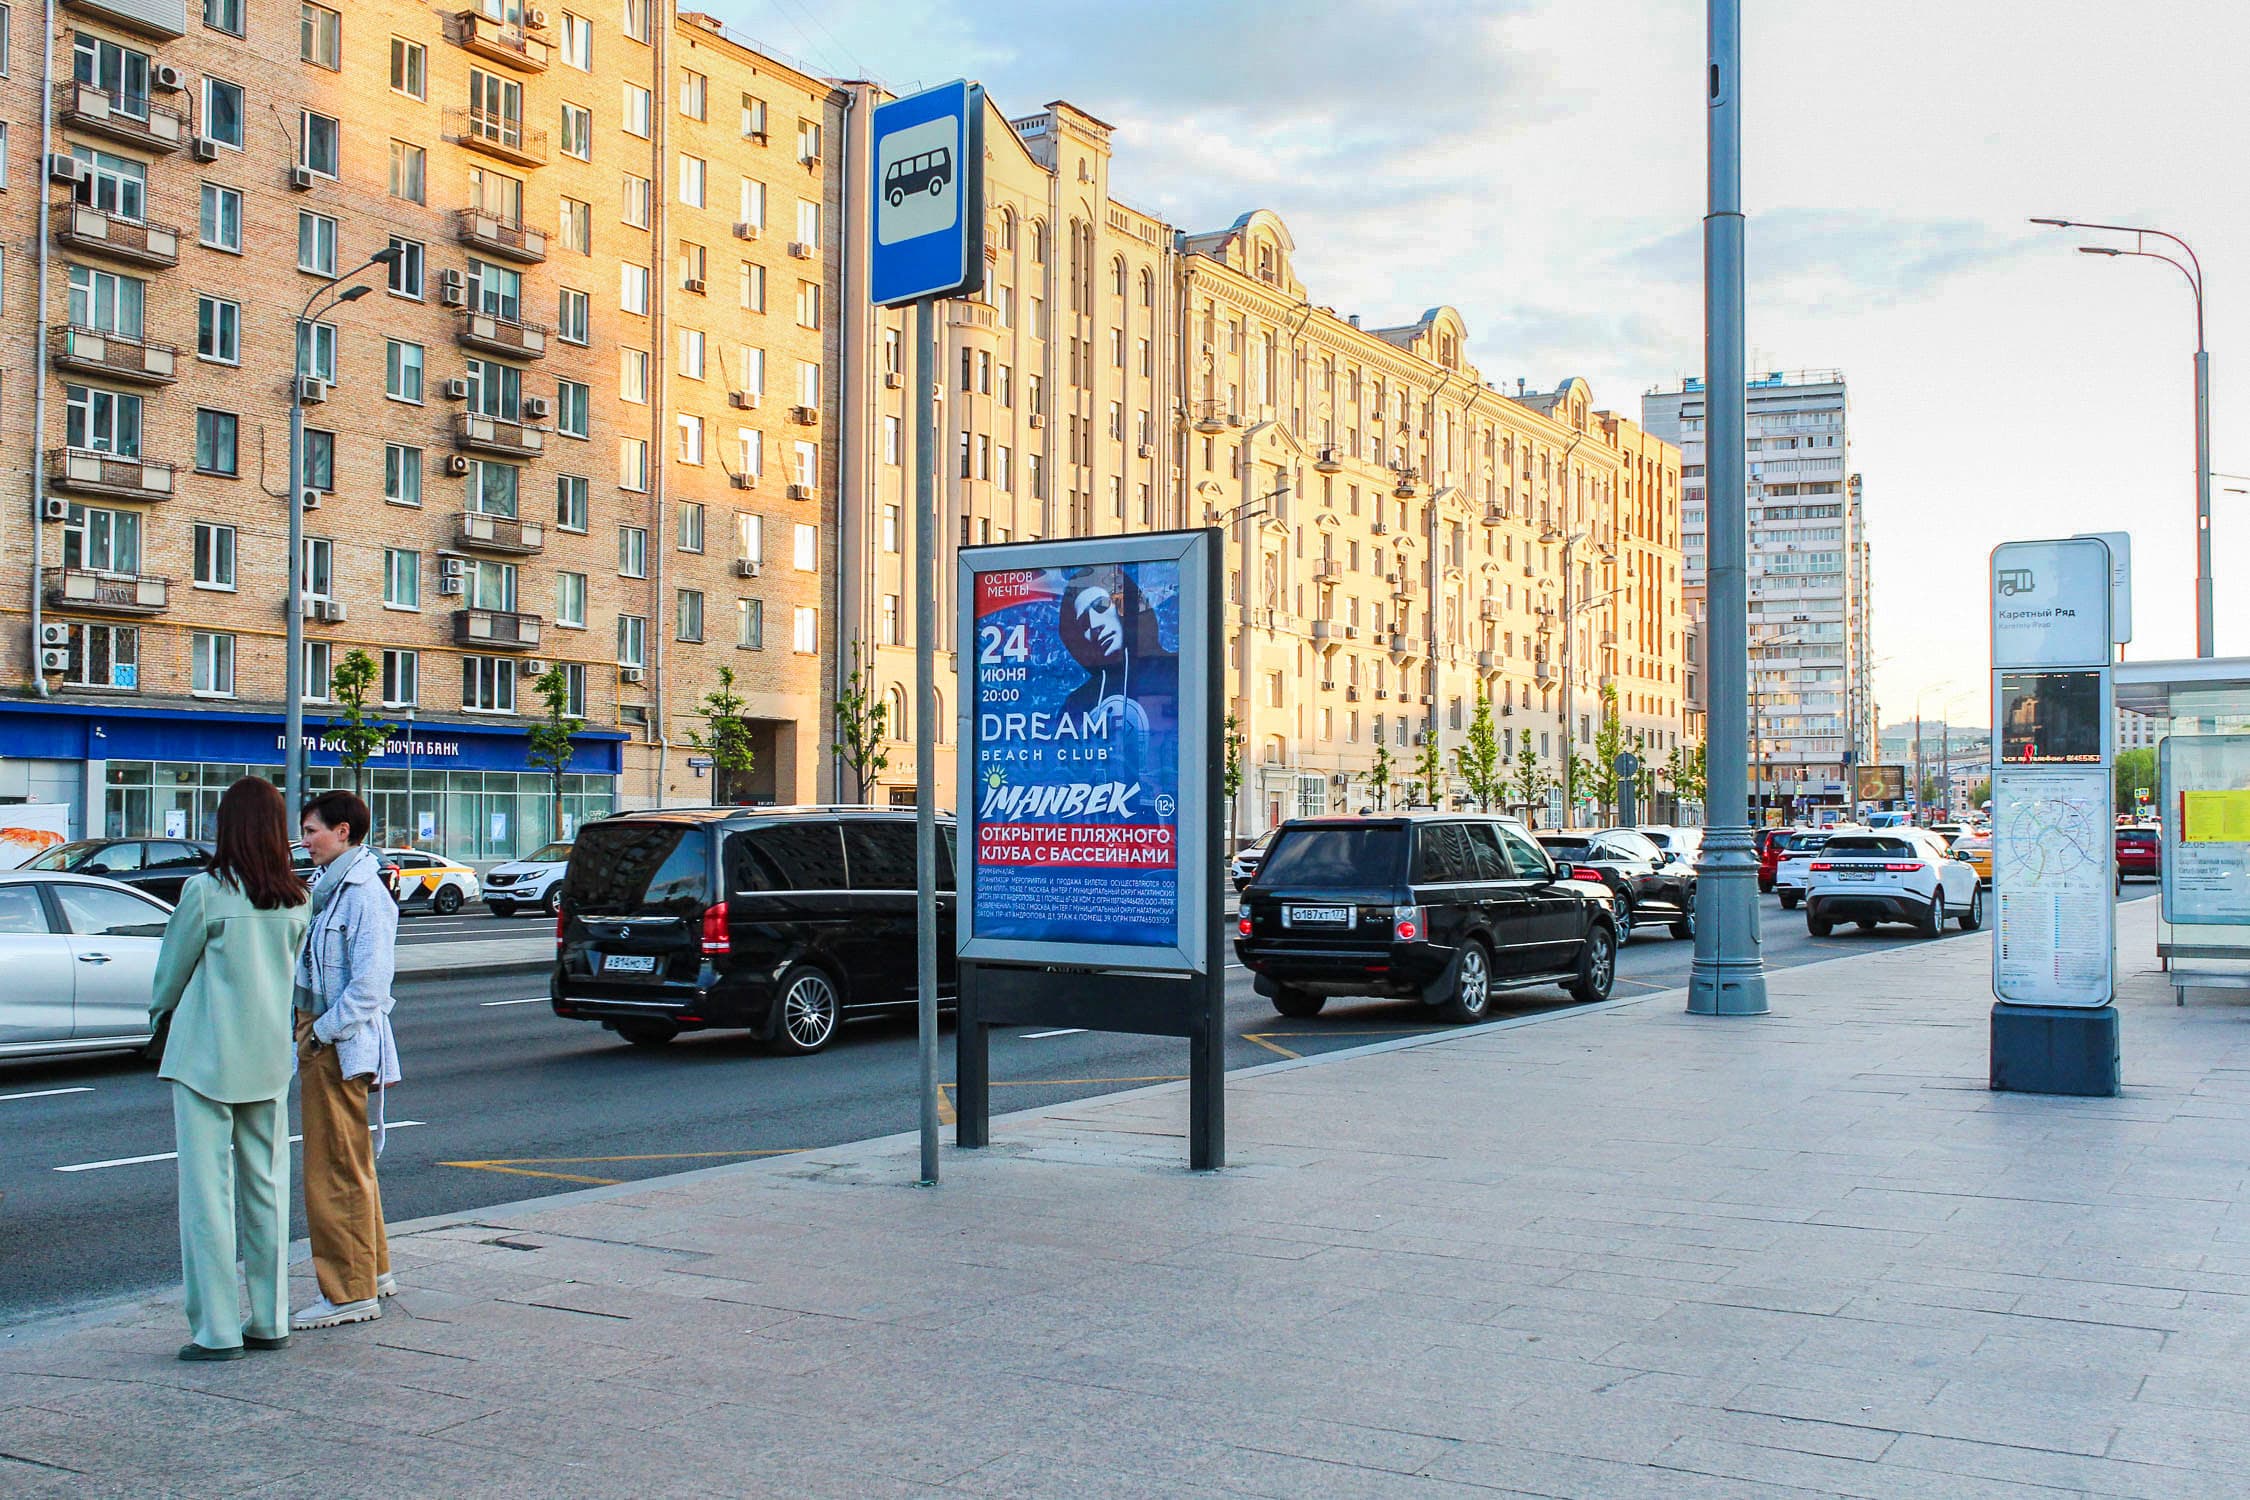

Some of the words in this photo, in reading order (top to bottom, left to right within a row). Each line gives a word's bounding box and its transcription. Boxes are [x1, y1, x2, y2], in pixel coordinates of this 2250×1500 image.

[984, 571, 1033, 585] ОСТРОВ
[987, 584, 1029, 598] МЕЧТЫ
[1999, 608, 2052, 620] Каретный
[2055, 607, 2076, 617] Ряд
[980, 624, 1029, 665] 24
[981, 667, 1026, 682] ИЮНЯ
[982, 688, 1020, 702] 20:00
[981, 712, 1108, 741] DREAM
[277, 735, 316, 751] ПТА
[387, 740, 424, 755] ПОЧТА
[426, 741, 459, 756] БАНК
[981, 749, 1043, 761] BEACH
[1157, 799, 1174, 811] 12+
[981, 826, 1067, 842] ОТКРЫТИЕ
[1071, 828, 1170, 844] ПЛЯЖНОГО
[981, 846, 1032, 861] КЛУБА
[1035, 847, 1046, 861] С
[1050, 842, 1169, 864] БАССЕЙНАМИ
